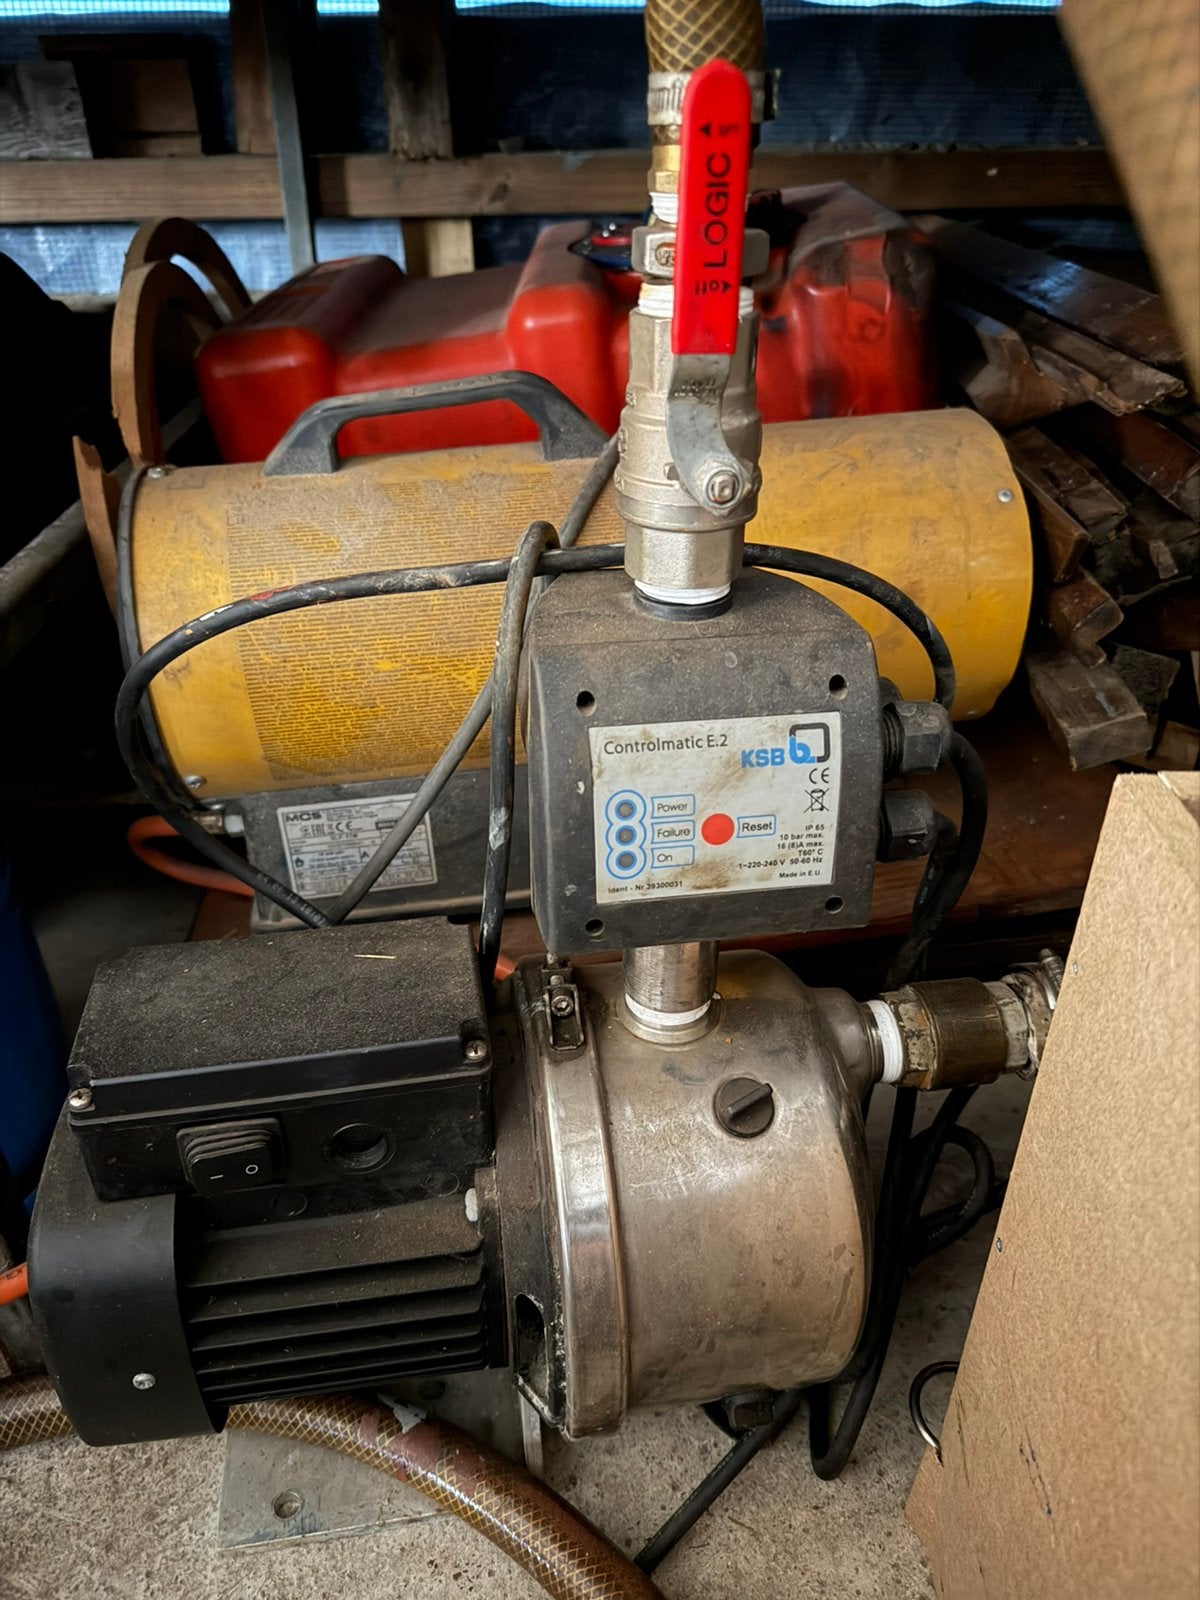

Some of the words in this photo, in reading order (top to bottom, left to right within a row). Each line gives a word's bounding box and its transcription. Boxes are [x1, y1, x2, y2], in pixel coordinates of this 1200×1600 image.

[703, 152, 731, 268] LOGIC
[604, 736, 703, 755] Controlmatic
[706, 734, 728, 748] E.2
[741, 748, 785, 769] KSB
[657, 801, 688, 813] Power
[285, 811, 322, 822] MCS
[741, 821, 773, 832] Reset
[657, 827, 691, 839] Failure
[656, 853, 673, 863] On
[789, 857, 811, 866] 50-60
[608, 886, 628, 894] Ident
